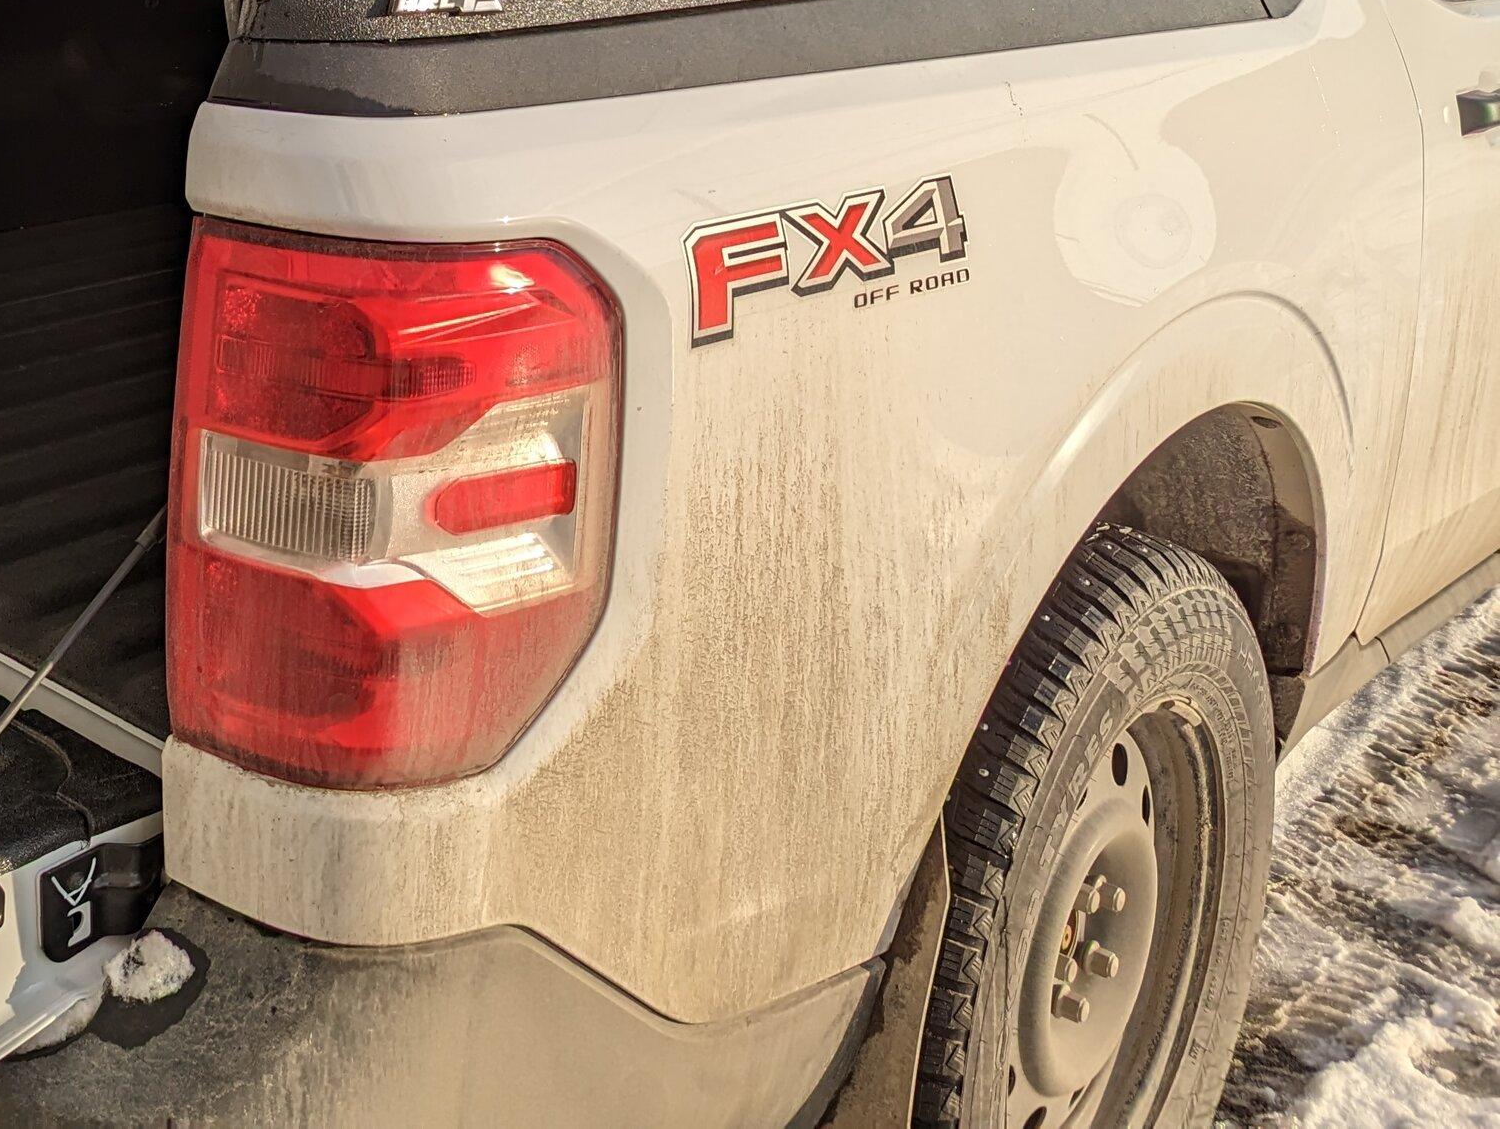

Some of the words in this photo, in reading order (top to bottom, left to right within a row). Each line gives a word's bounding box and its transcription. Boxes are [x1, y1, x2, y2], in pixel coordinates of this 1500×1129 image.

[683, 173, 968, 348] FX4
[854, 284, 899, 308] OFF
[909, 268, 970, 295] ROAD
